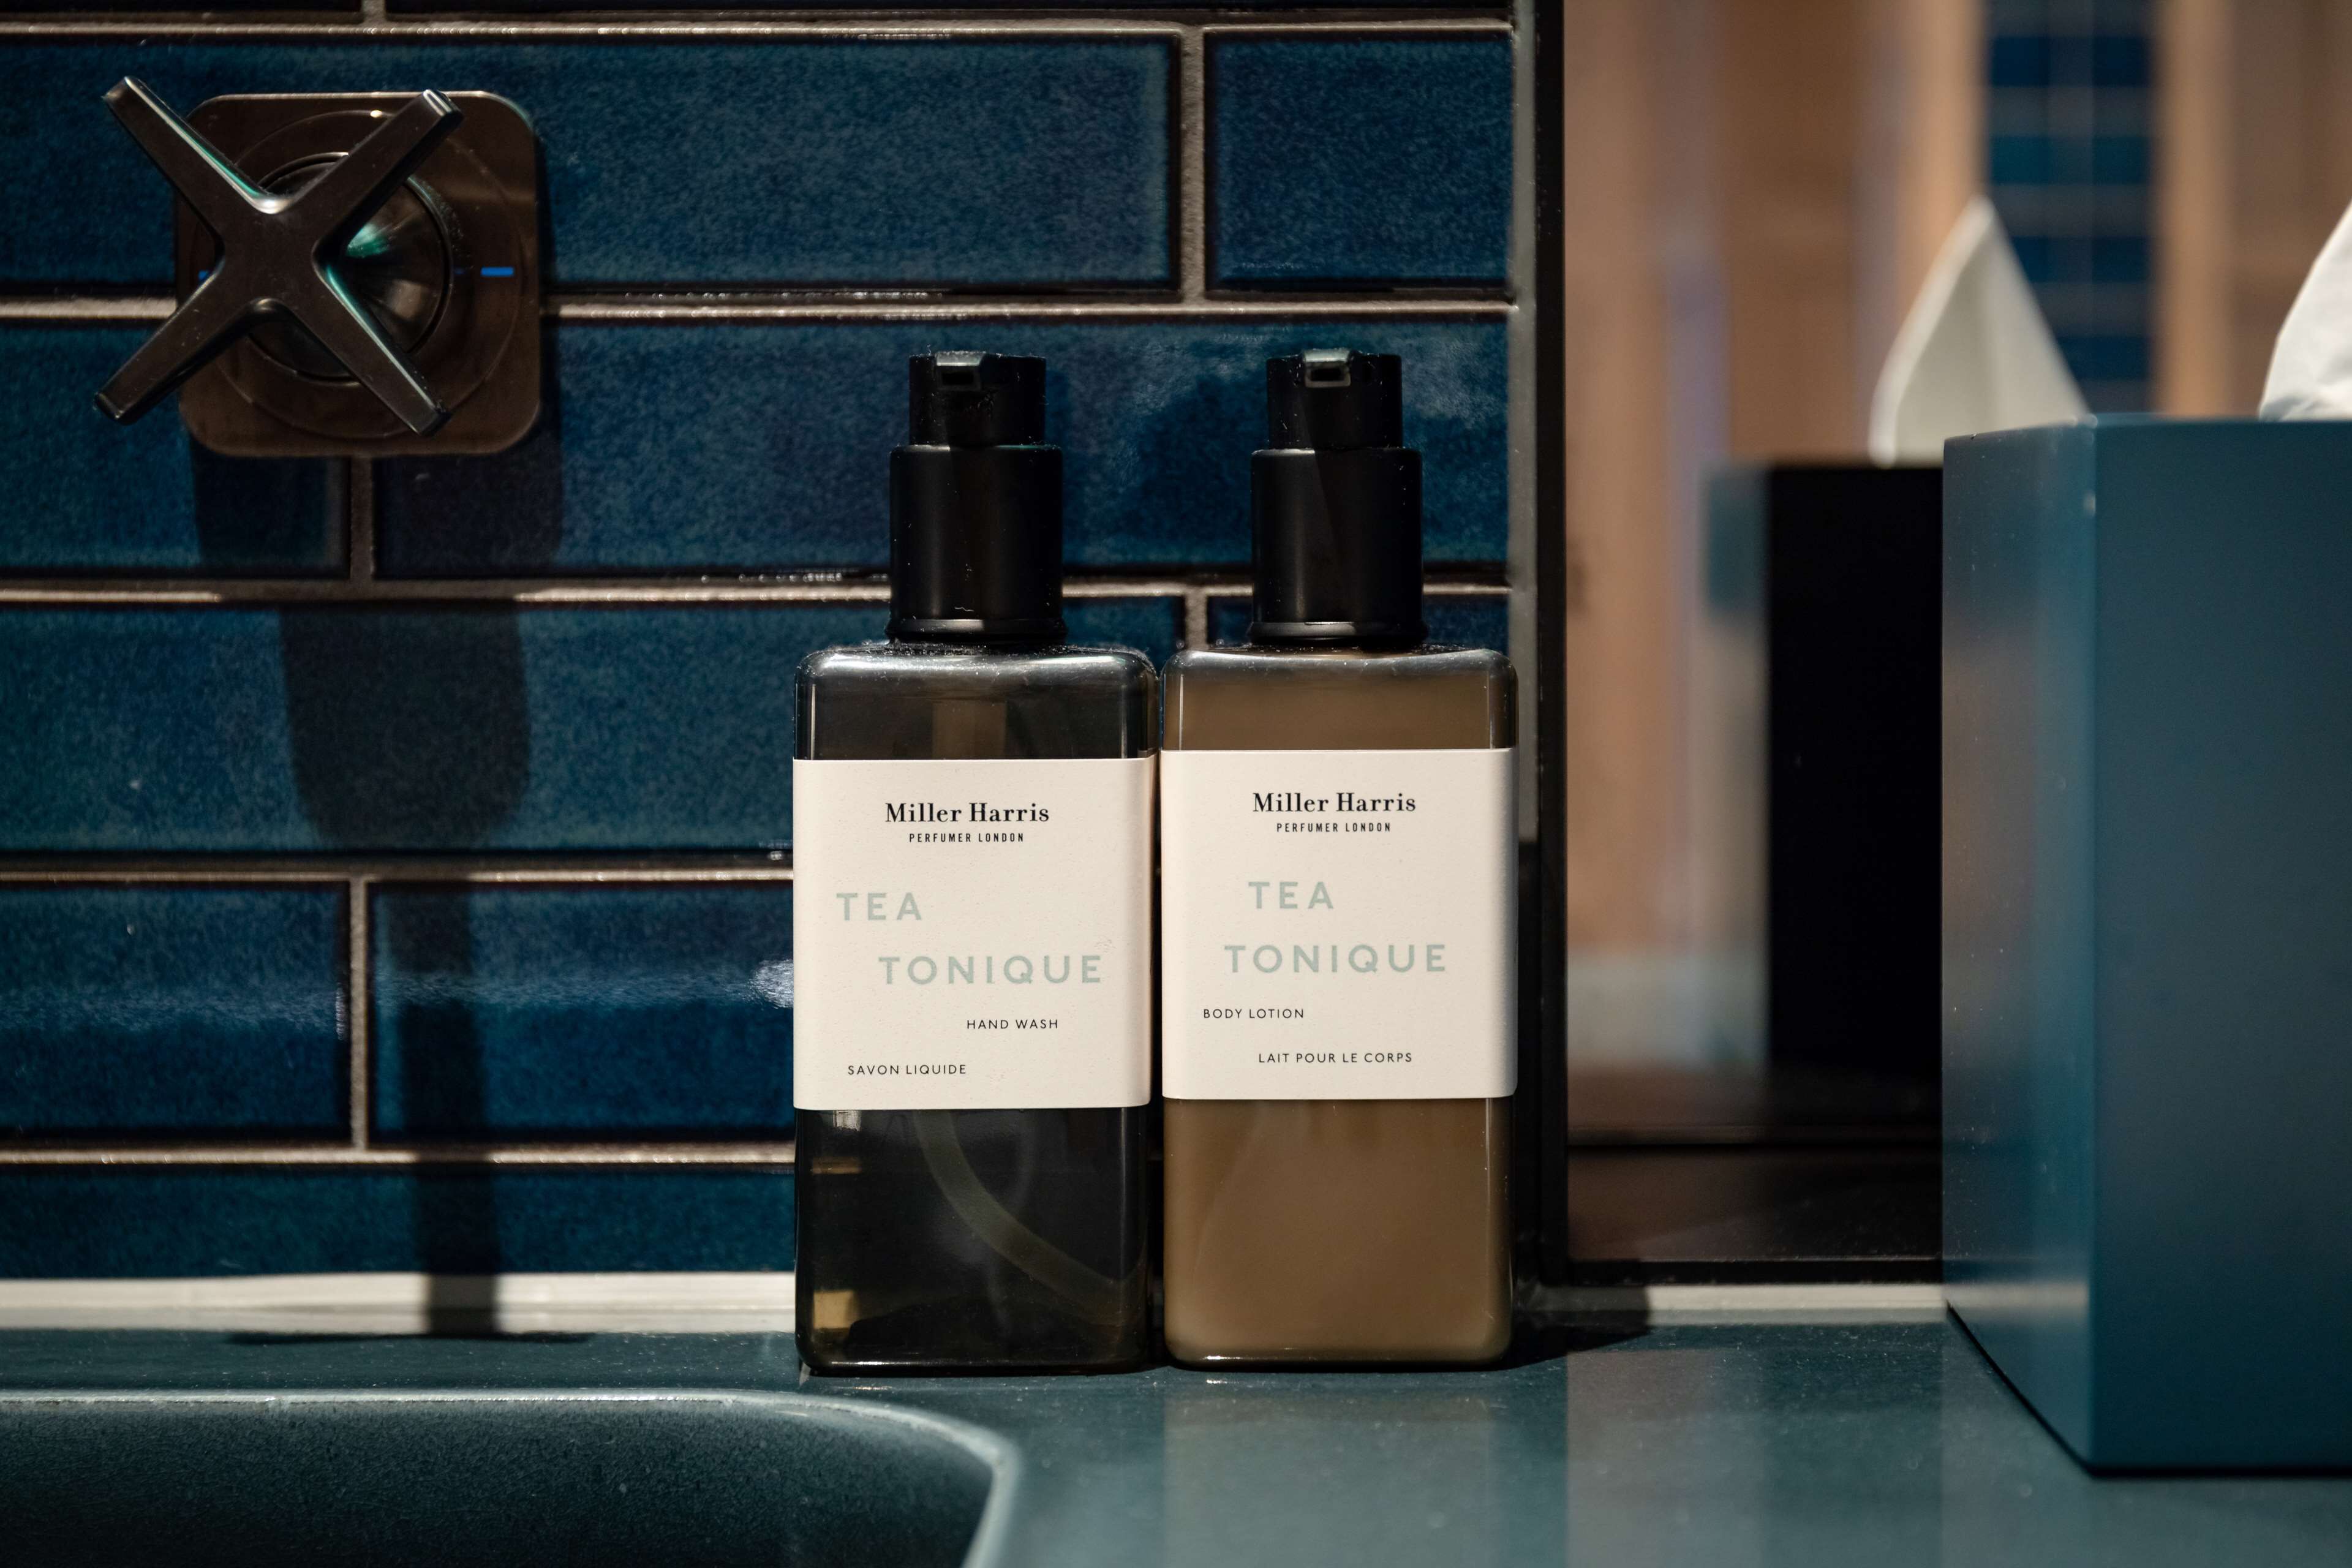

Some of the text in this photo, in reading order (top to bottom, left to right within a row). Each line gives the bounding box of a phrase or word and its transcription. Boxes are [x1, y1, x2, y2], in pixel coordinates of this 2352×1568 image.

[1253, 793, 1416, 812] Miller Harris
[885, 802, 1049, 823] Miller Harris
[1276, 822, 1390, 832] PERFUMER LONDON
[909, 832, 1023, 843] PERFUMER LONDON
[1248, 881, 1334, 910] TEA
[835, 892, 922, 921] TEA
[1224, 943, 1446, 974] TONIQUE
[878, 954, 1101, 986] TONIQUE
[1204, 1008, 1304, 1019] BODY LOTION
[967, 1019, 1058, 1030] HAND WASH
[1259, 1052, 1412, 1063] LAIT POUR LE CORPS
[848, 1064, 966, 1076] SAVON LIQUIDE
